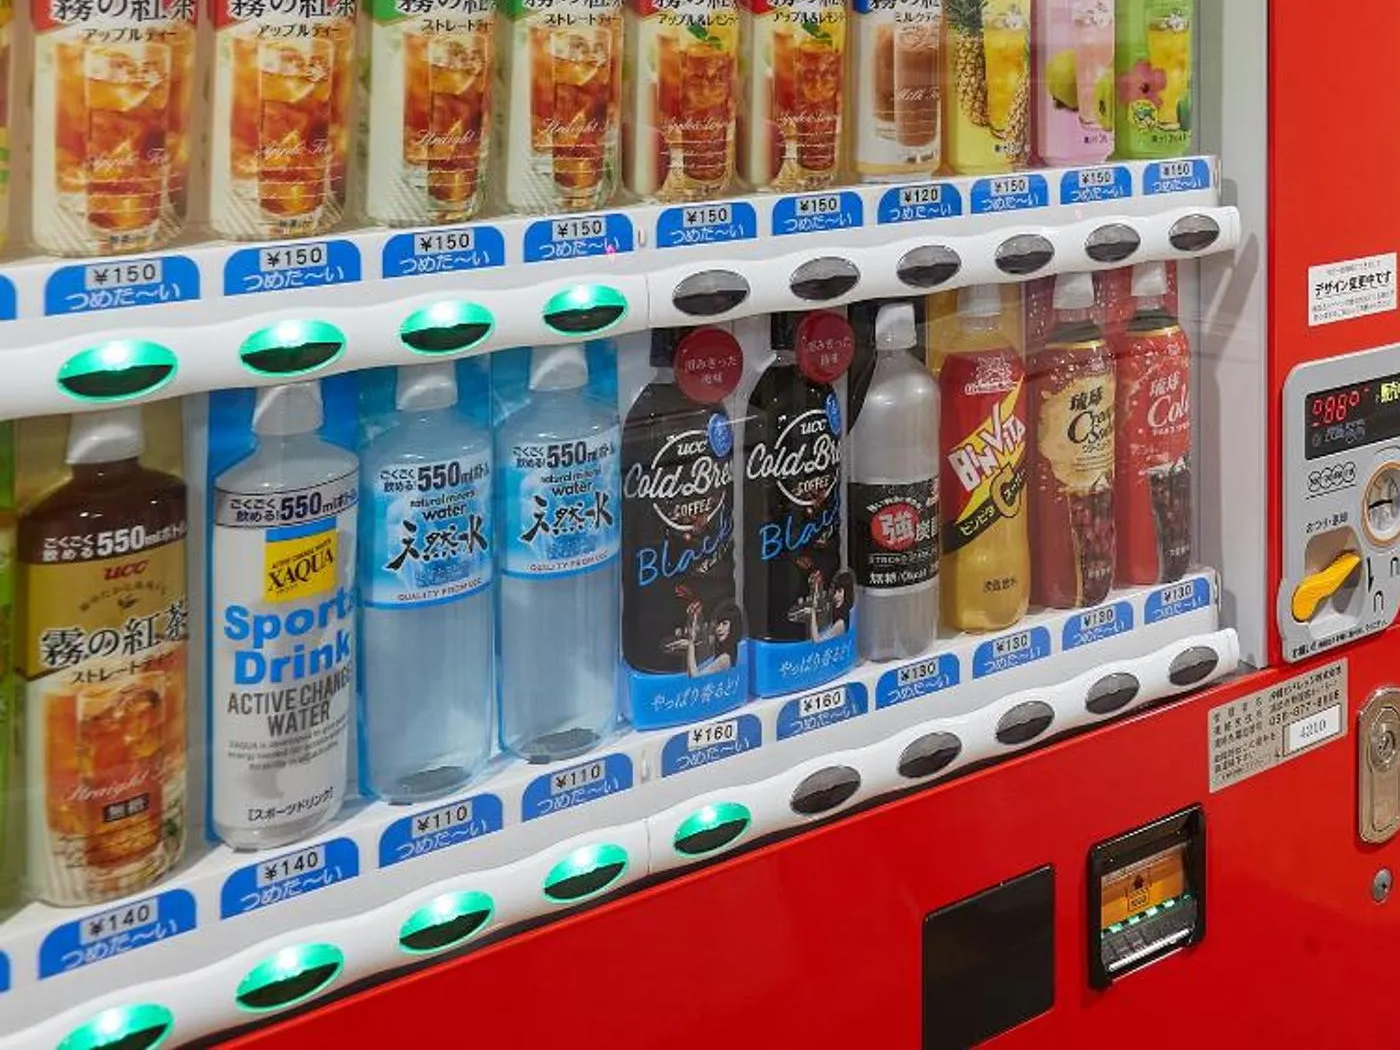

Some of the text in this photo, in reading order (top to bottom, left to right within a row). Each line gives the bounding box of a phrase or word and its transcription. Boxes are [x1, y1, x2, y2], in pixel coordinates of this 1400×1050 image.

[800, 196, 838, 213] ¥150
[904, 187, 938, 204] ¥120
[556, 219, 602, 238] ¥150
[686, 206, 728, 225] ¥150
[420, 233, 470, 252] ¥150
[266, 248, 322, 268] ¥150
[94, 263, 156, 285] ¥150
[746, 438, 802, 480] Cold
[552, 481, 592, 498] water
[624, 461, 683, 499] Cold
[422, 503, 467, 522] water
[521, 492, 613, 542] 天然水
[760, 495, 840, 560] Blac
[384, 514, 488, 572] 天然水
[267, 548, 334, 588] XAQUA
[42, 602, 188, 667] 霧の紅茶
[234, 629, 350, 684] Drink
[901, 661, 936, 683] ¥130
[228, 688, 297, 714] ACTIVE
[268, 702, 330, 737] WATER
[556, 764, 602, 790] ¥110
[416, 807, 468, 834] ¥110
[264, 850, 319, 881] ¥140
[89, 903, 150, 938] ¥140
